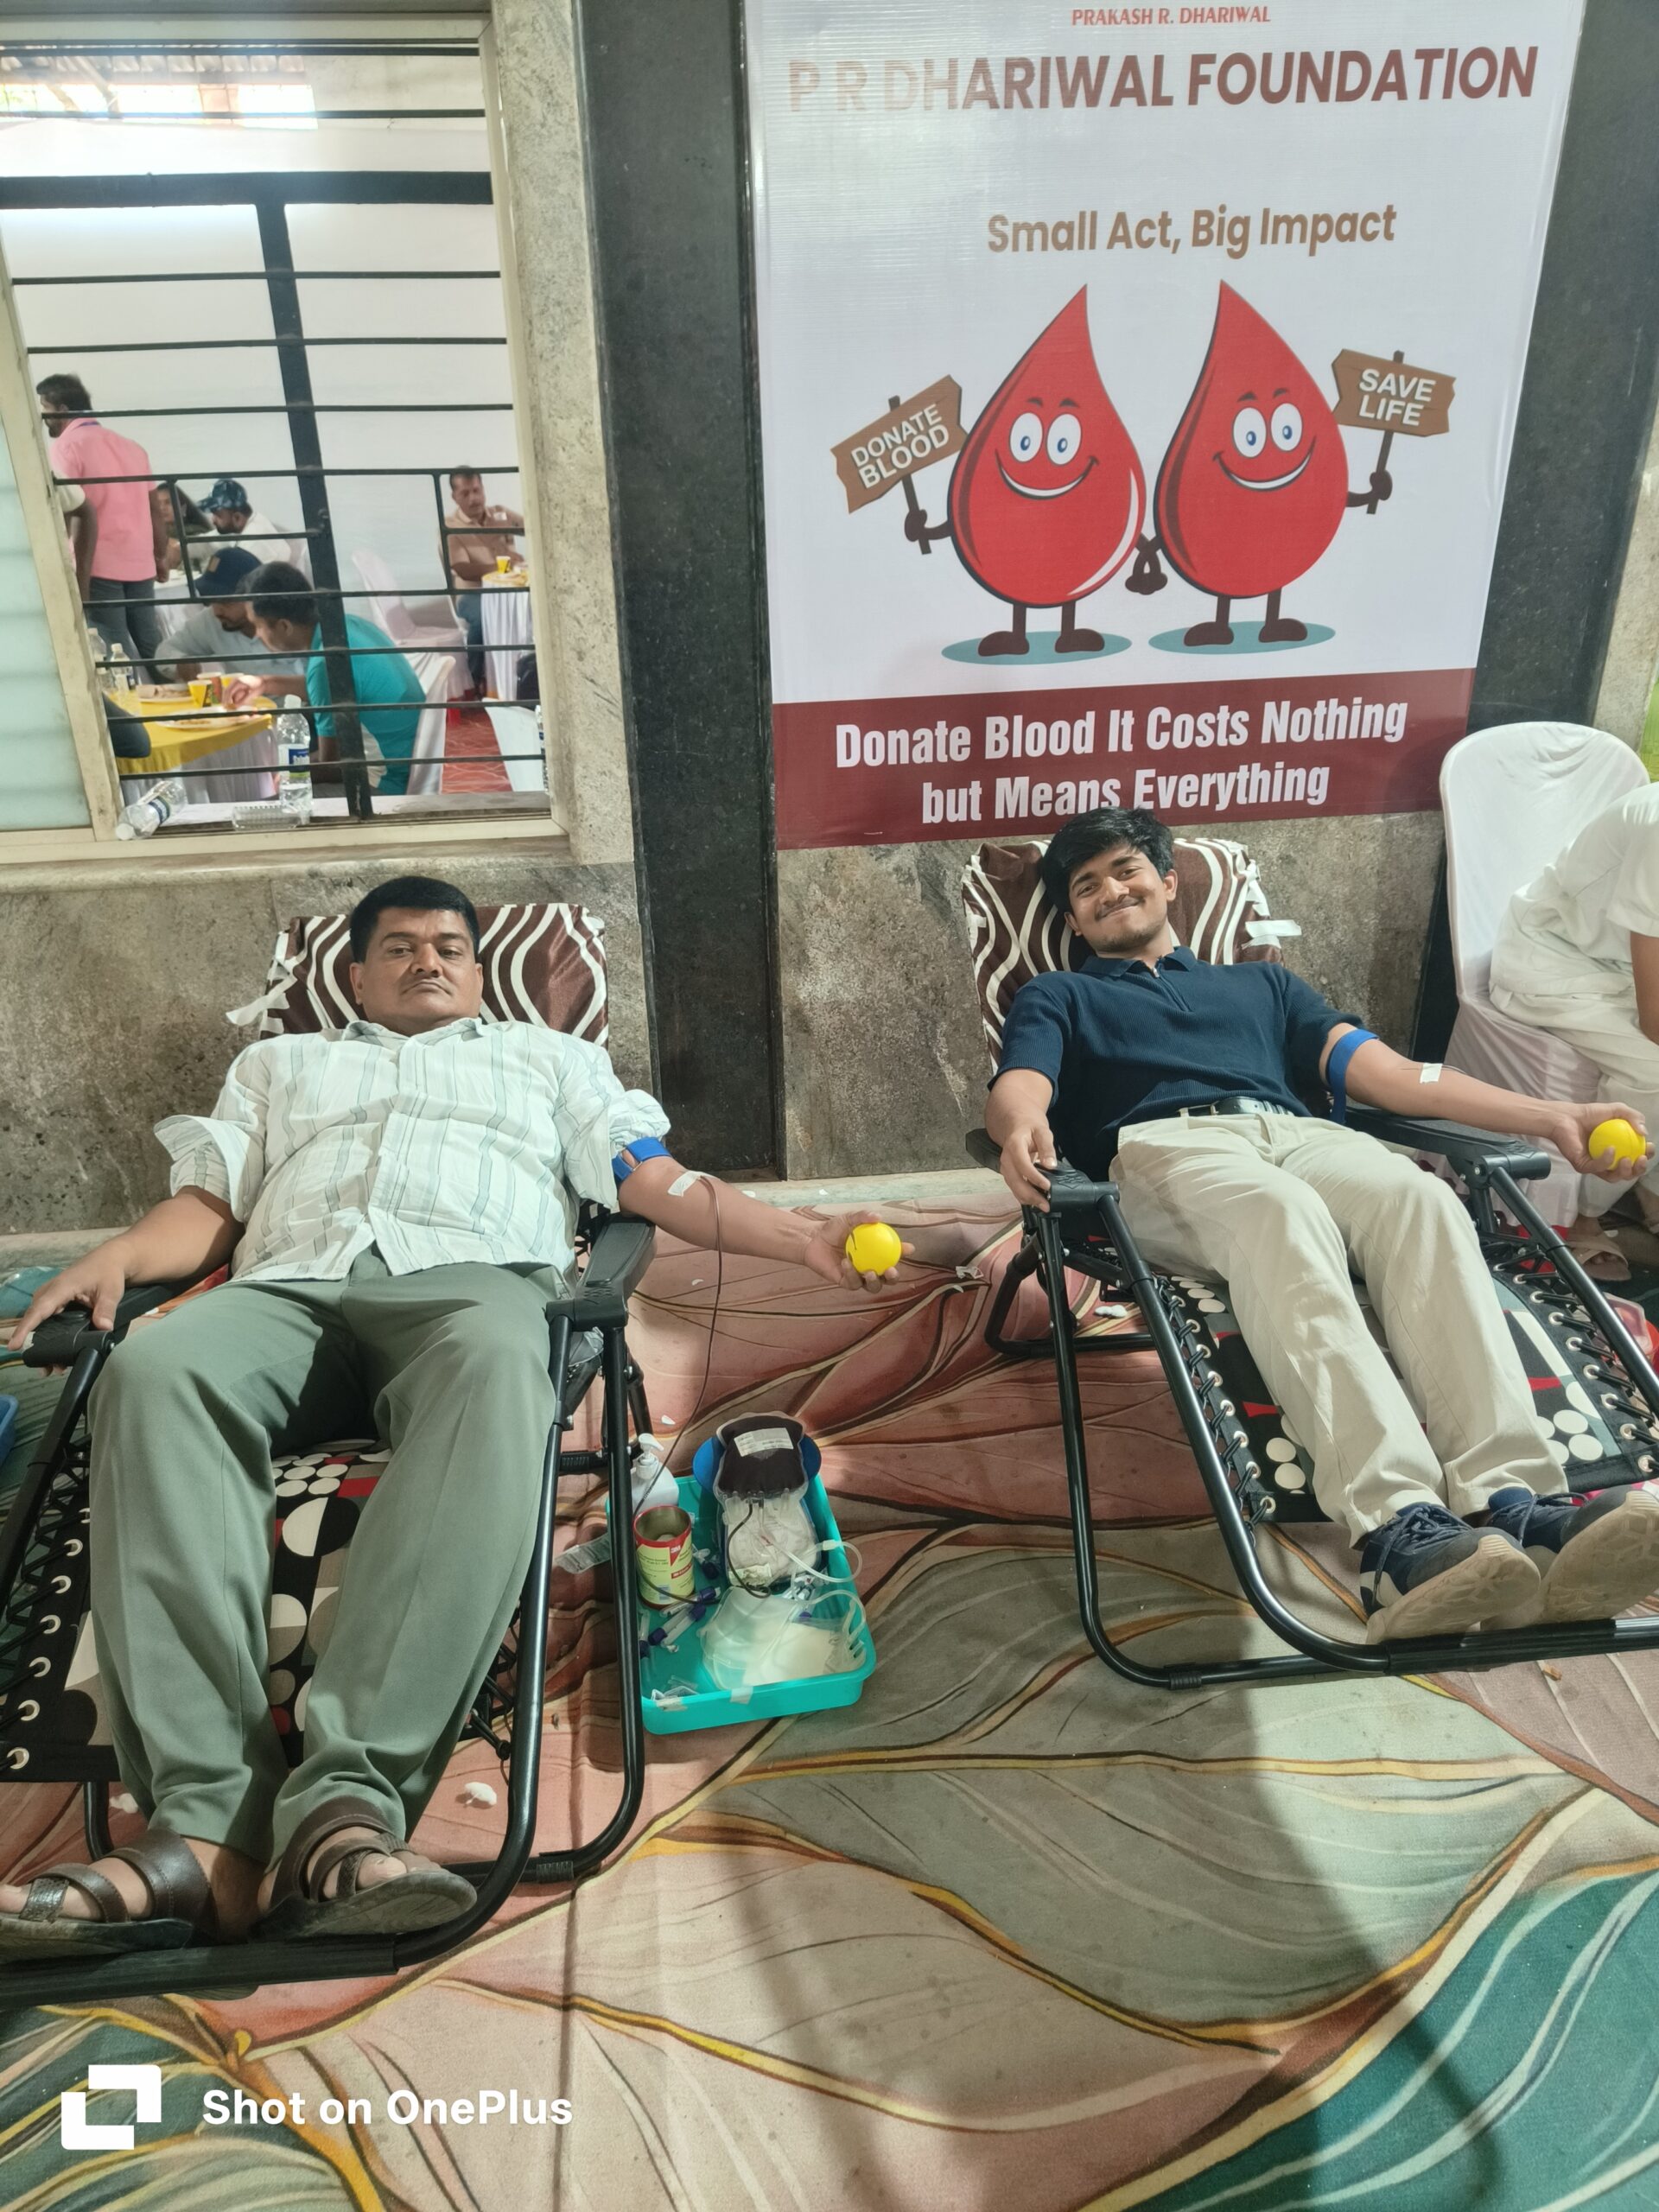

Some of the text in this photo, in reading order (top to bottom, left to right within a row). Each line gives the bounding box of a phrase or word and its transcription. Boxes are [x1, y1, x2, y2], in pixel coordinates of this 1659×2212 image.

[1072, 5, 1271, 26] PRAKASH R. DHARIWAL
[788, 46, 1538, 112] P R DHARIWAL FOUNDATION
[988, 203, 1397, 260] Small Act, Big Impact
[1358, 395, 1423, 426] LIFE
[1359, 368, 1436, 402] SAVE
[851, 404, 943, 467] DONATE
[858, 423, 950, 489] BLOOD
[836, 696, 1408, 769] Donate Blood It Costs Nothing
[922, 762, 1330, 824] but Means Everything
